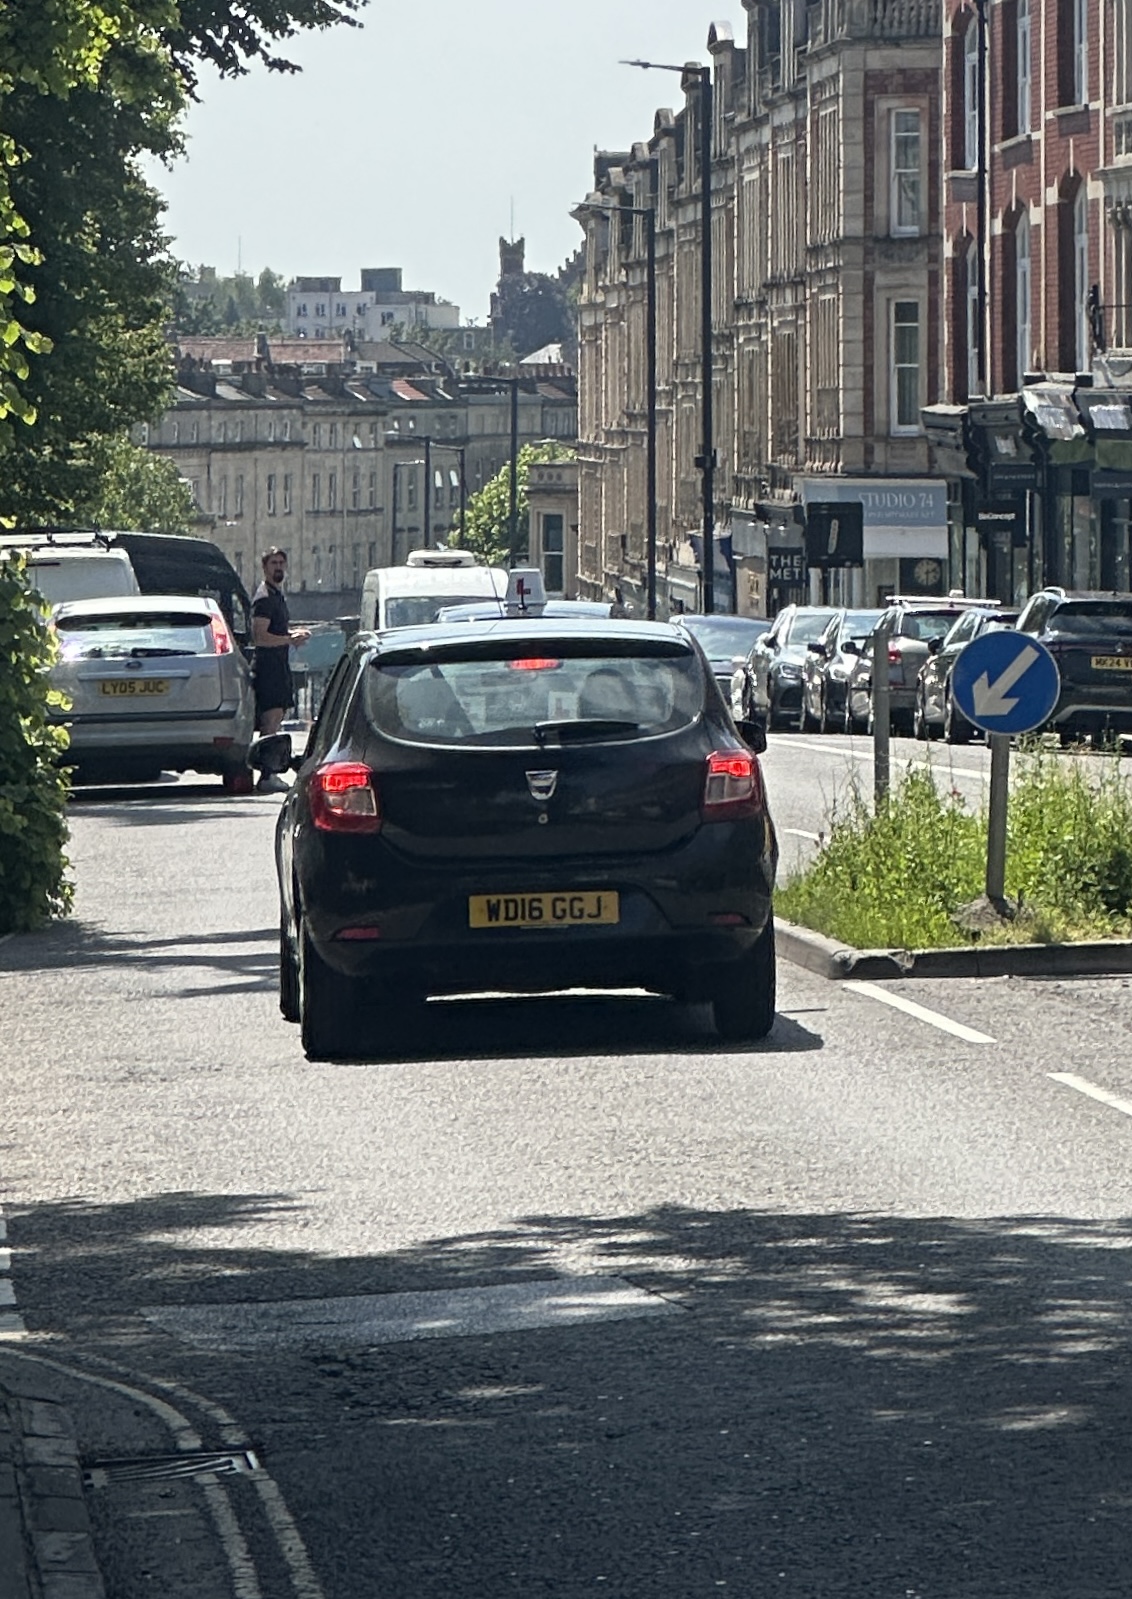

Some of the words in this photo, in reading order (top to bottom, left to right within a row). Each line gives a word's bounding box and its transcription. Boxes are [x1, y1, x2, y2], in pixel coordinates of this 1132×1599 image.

[858, 492, 916, 508] STUDIO
[918, 492, 934, 508] 74
[770, 554, 802, 567] THE
[102, 681, 136, 695] LY05
[139, 681, 164, 694] JUC
[486, 898, 544, 922] WD16
[551, 896, 604, 920] GGJ
